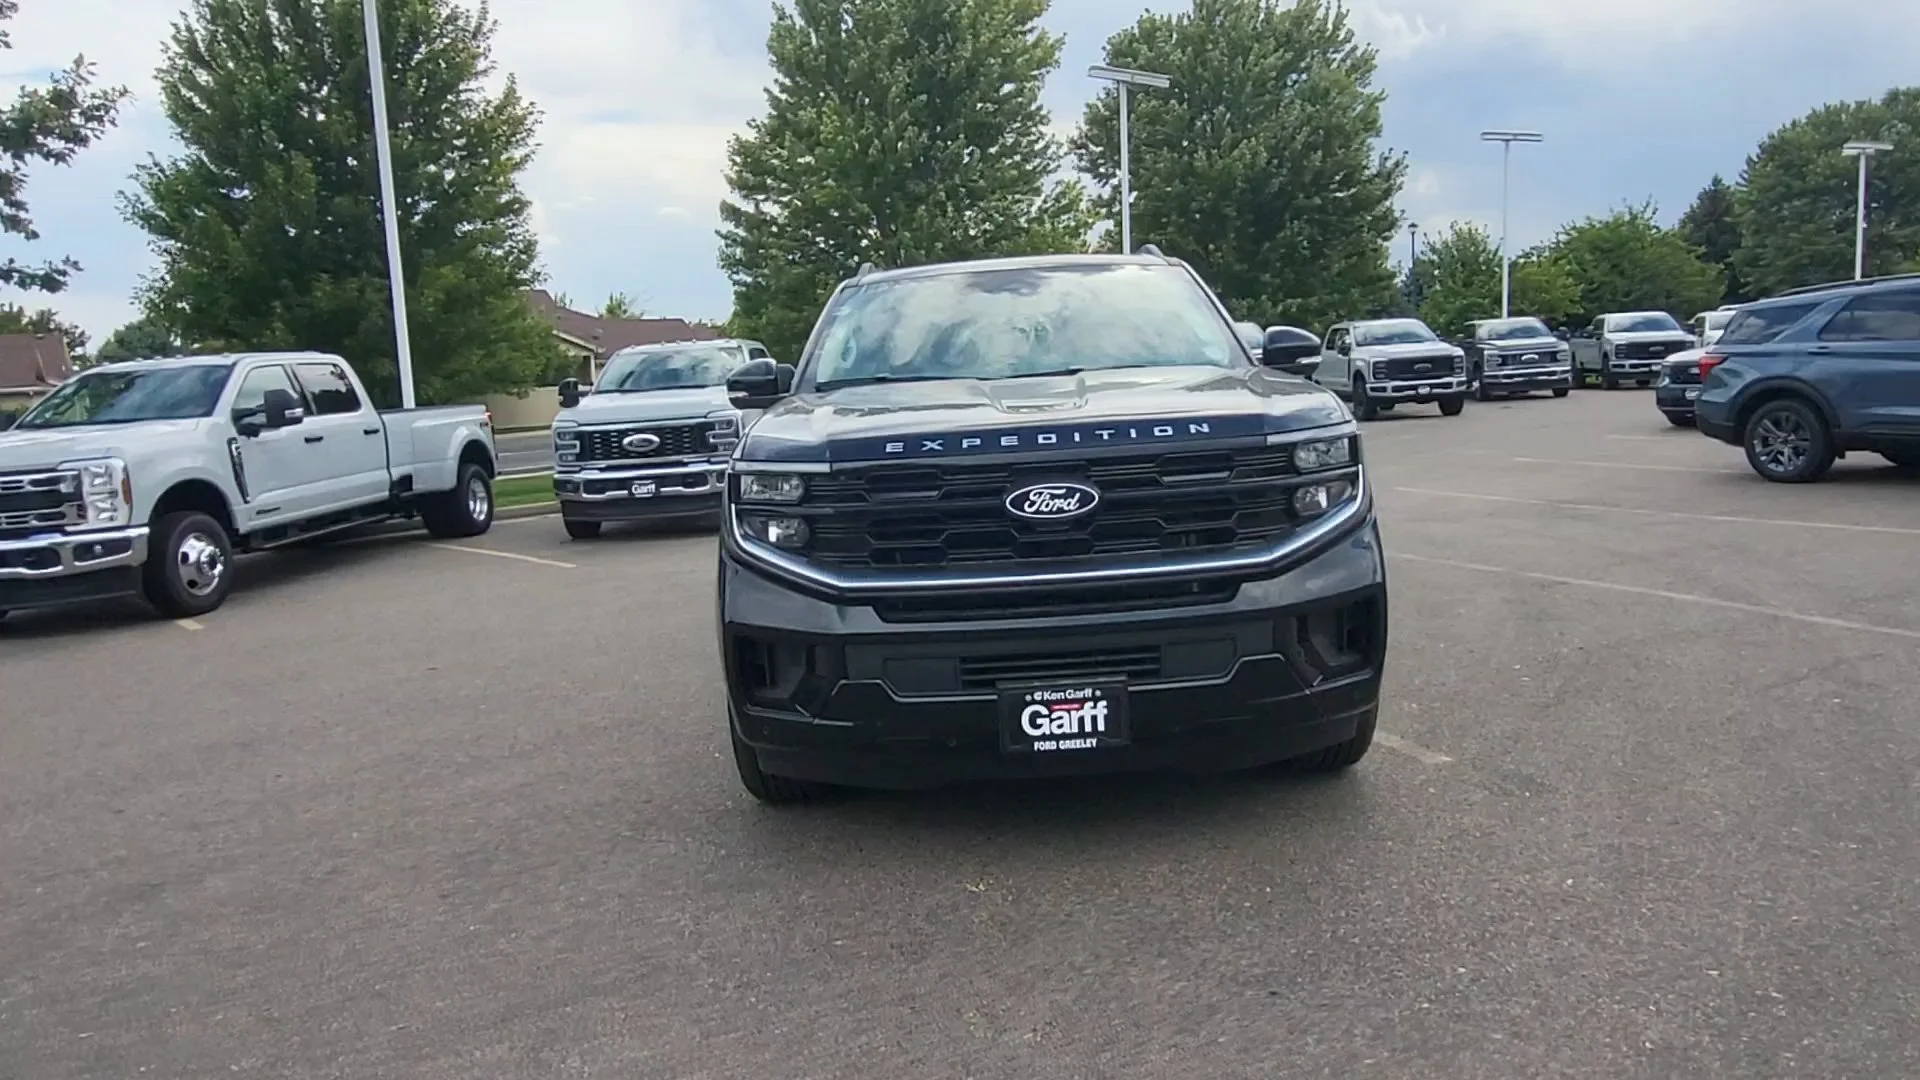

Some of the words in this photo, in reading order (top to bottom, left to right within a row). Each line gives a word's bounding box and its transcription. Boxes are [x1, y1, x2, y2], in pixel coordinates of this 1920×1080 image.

[885, 422, 1211, 453] EXPEDITION
[1023, 487, 1081, 513] Ford
[1043, 690, 1065, 701] Ken
[1066, 688, 1092, 699] Garff
[1021, 700, 1108, 736] Garff
[1033, 740, 1057, 751] FORD
[1059, 738, 1097, 749] GREELEY
